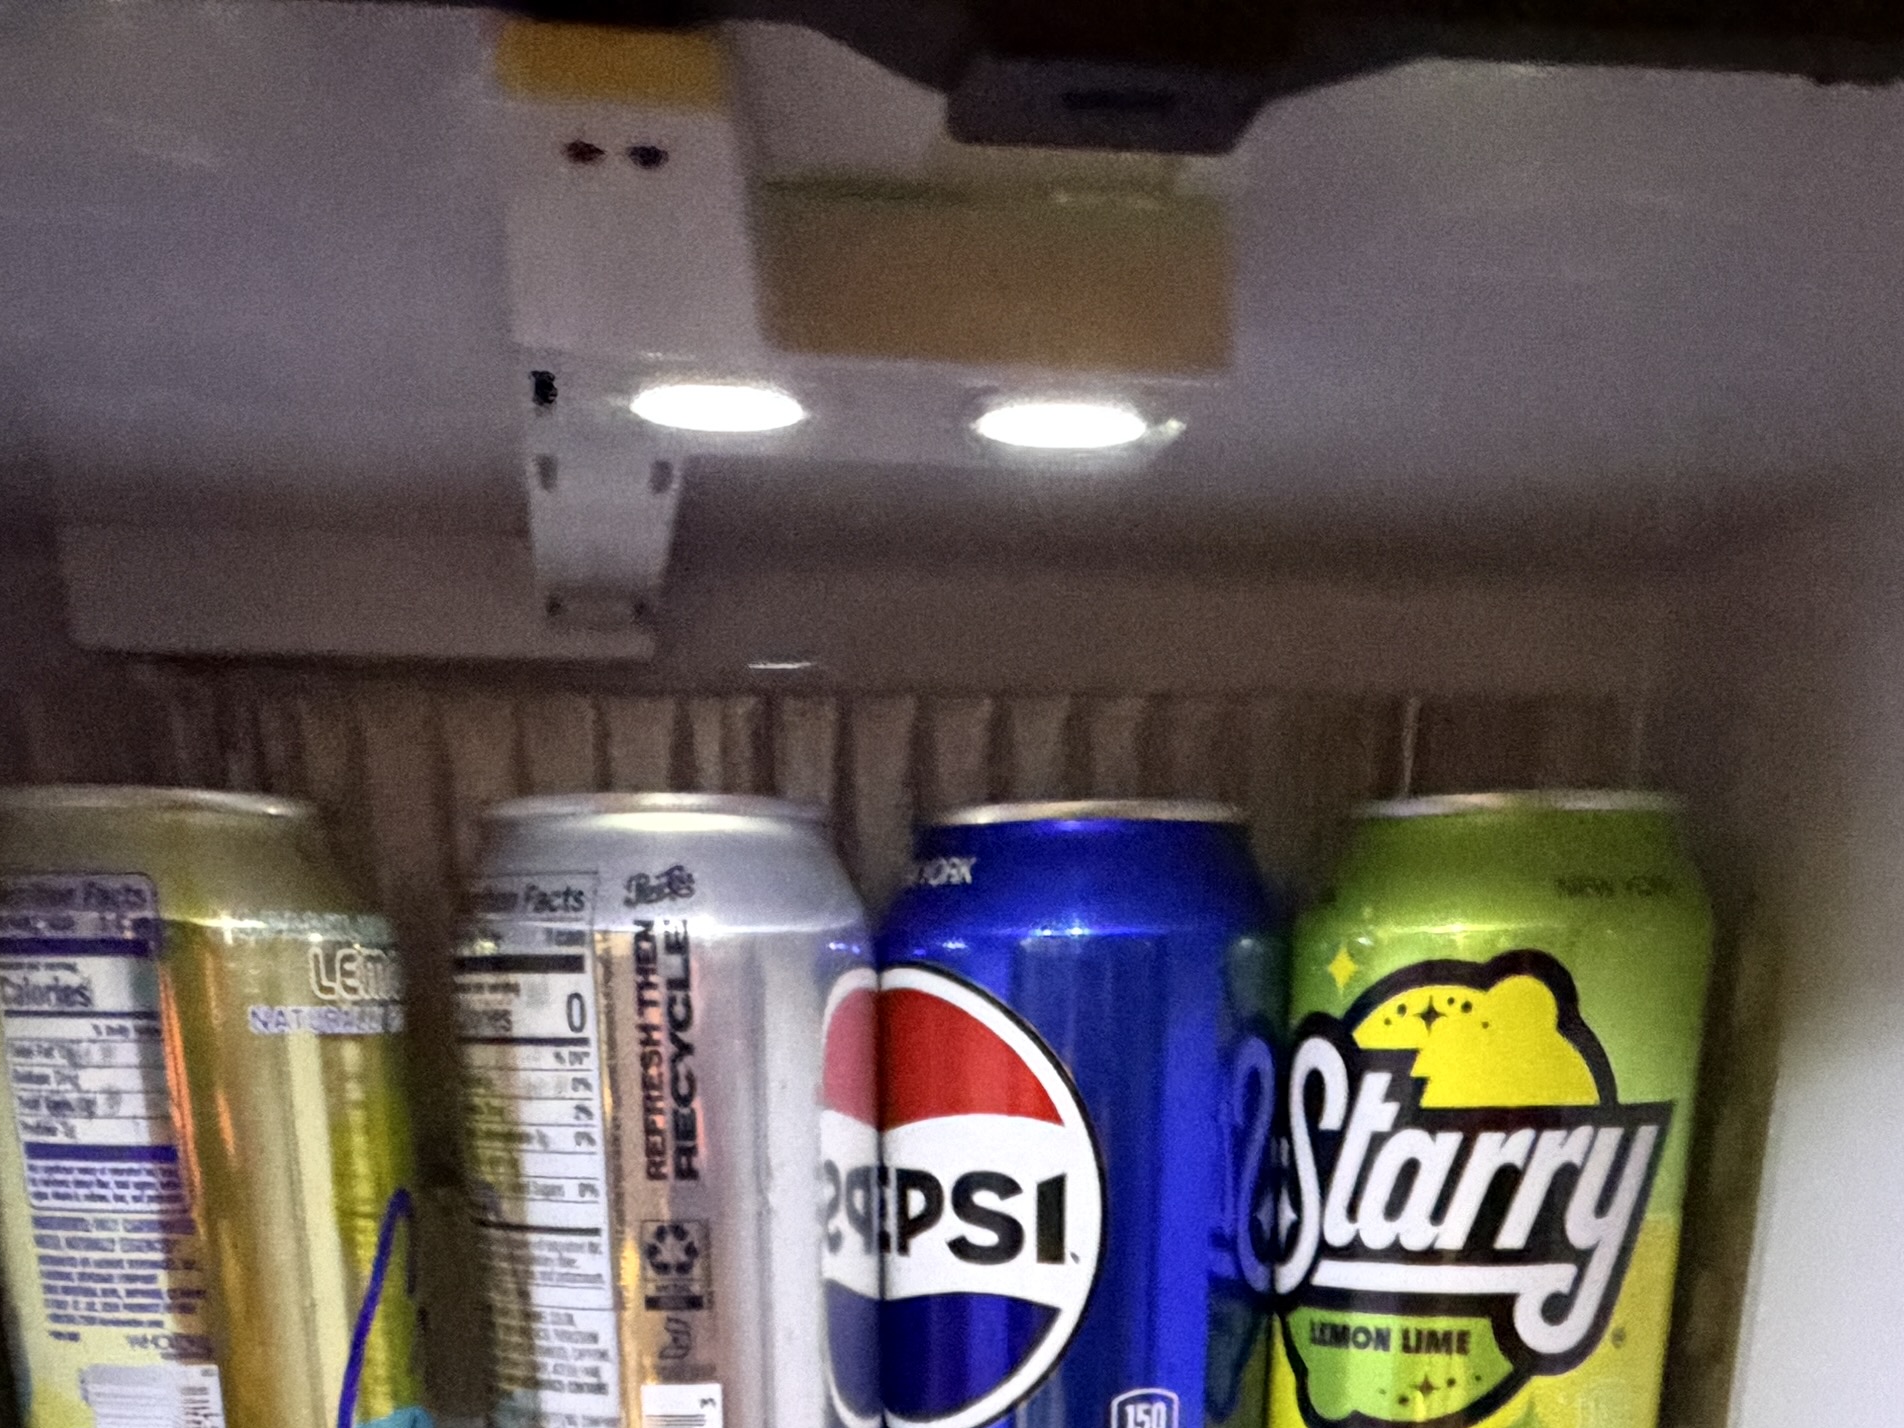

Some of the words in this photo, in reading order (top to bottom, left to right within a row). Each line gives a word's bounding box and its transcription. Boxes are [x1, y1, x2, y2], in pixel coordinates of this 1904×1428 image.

[565, 992, 587, 1033] 0
[663, 919, 698, 1182] RECYCLE
[880, 1164, 1068, 1266] PSI
[1275, 1037, 1660, 1354] Starry
[1310, 1320, 1391, 1351] LEMON
[1401, 1326, 1472, 1355] LIME
